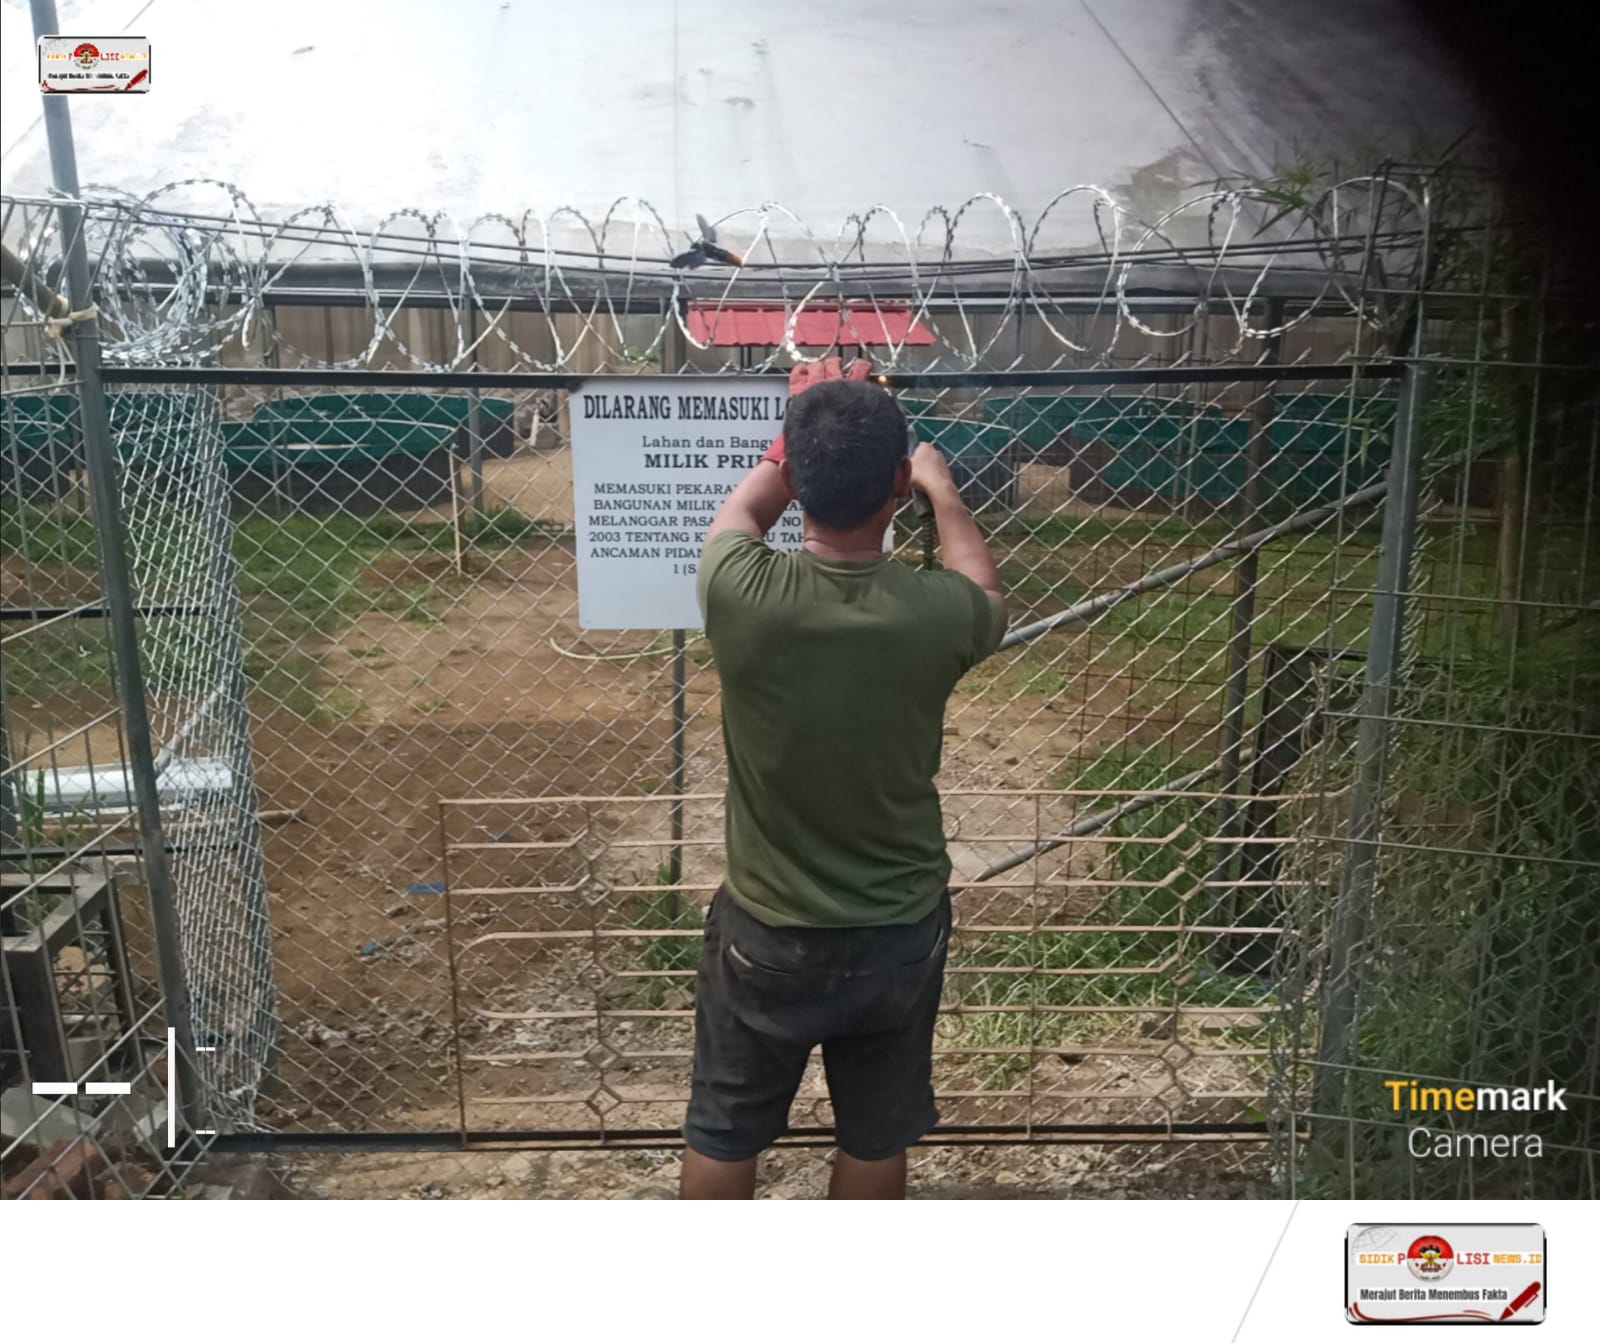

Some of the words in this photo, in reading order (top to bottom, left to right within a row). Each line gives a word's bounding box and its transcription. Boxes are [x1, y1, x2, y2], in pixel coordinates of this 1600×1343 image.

[583, 394, 671, 420] DILARANG
[677, 395, 770, 421] MEMASUKI
[642, 435, 691, 448] Lahan
[695, 436, 725, 448] dan
[643, 453, 709, 469] MILIK
[593, 482, 672, 495] MEMASUKI
[675, 483, 738, 495] PEKARA
[593, 498, 672, 511] BANGUNAN
[676, 499, 716, 511] MILIK
[588, 514, 678, 527] MELANGGAR
[588, 530, 621, 543] 2003
[624, 531, 690, 543] TENTANG
[589, 546, 661, 559] ANCAMAN
